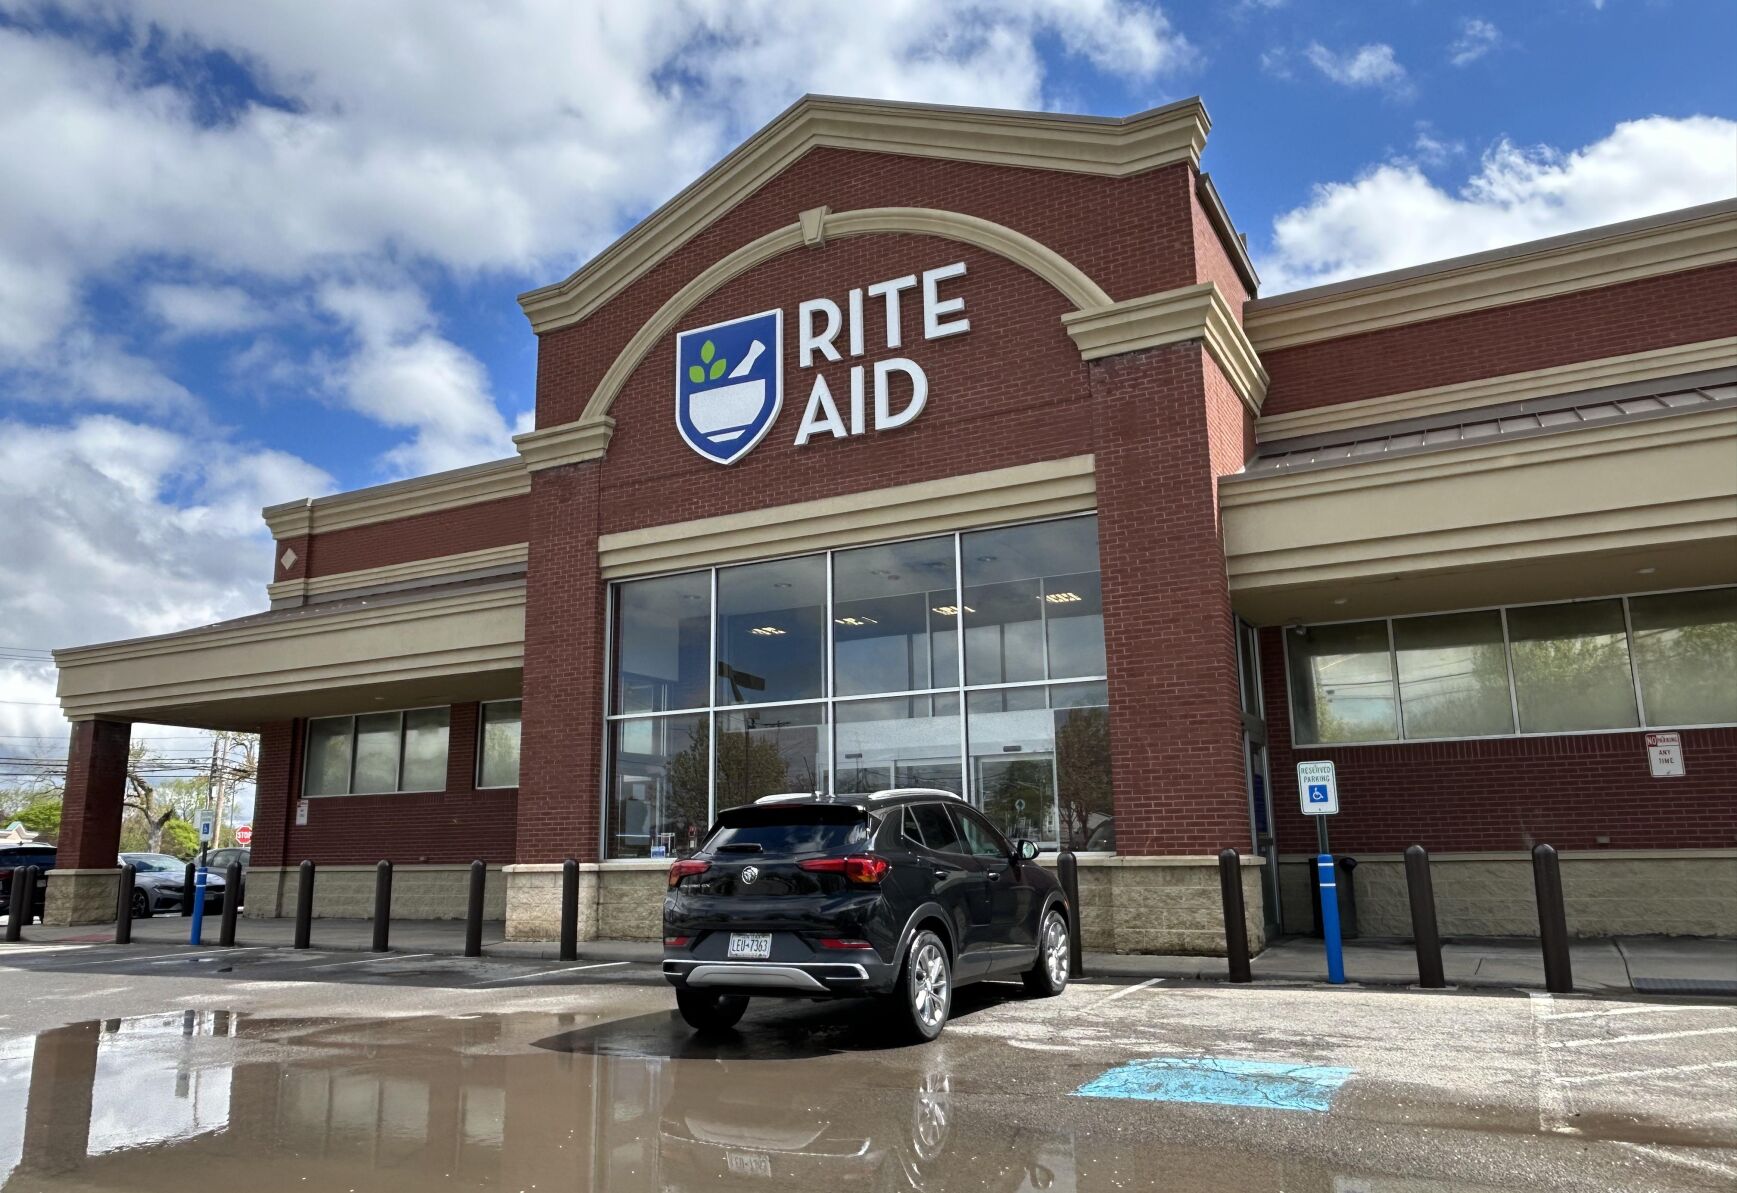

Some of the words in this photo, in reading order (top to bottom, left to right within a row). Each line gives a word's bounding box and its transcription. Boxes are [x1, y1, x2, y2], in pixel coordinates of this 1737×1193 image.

[799, 262, 970, 368] RITE
[794, 358, 928, 445] AID
[1647, 736, 1657, 746] NO
[1301, 766, 1331, 774] RESERVED
[1304, 775, 1330, 783] PARKING
